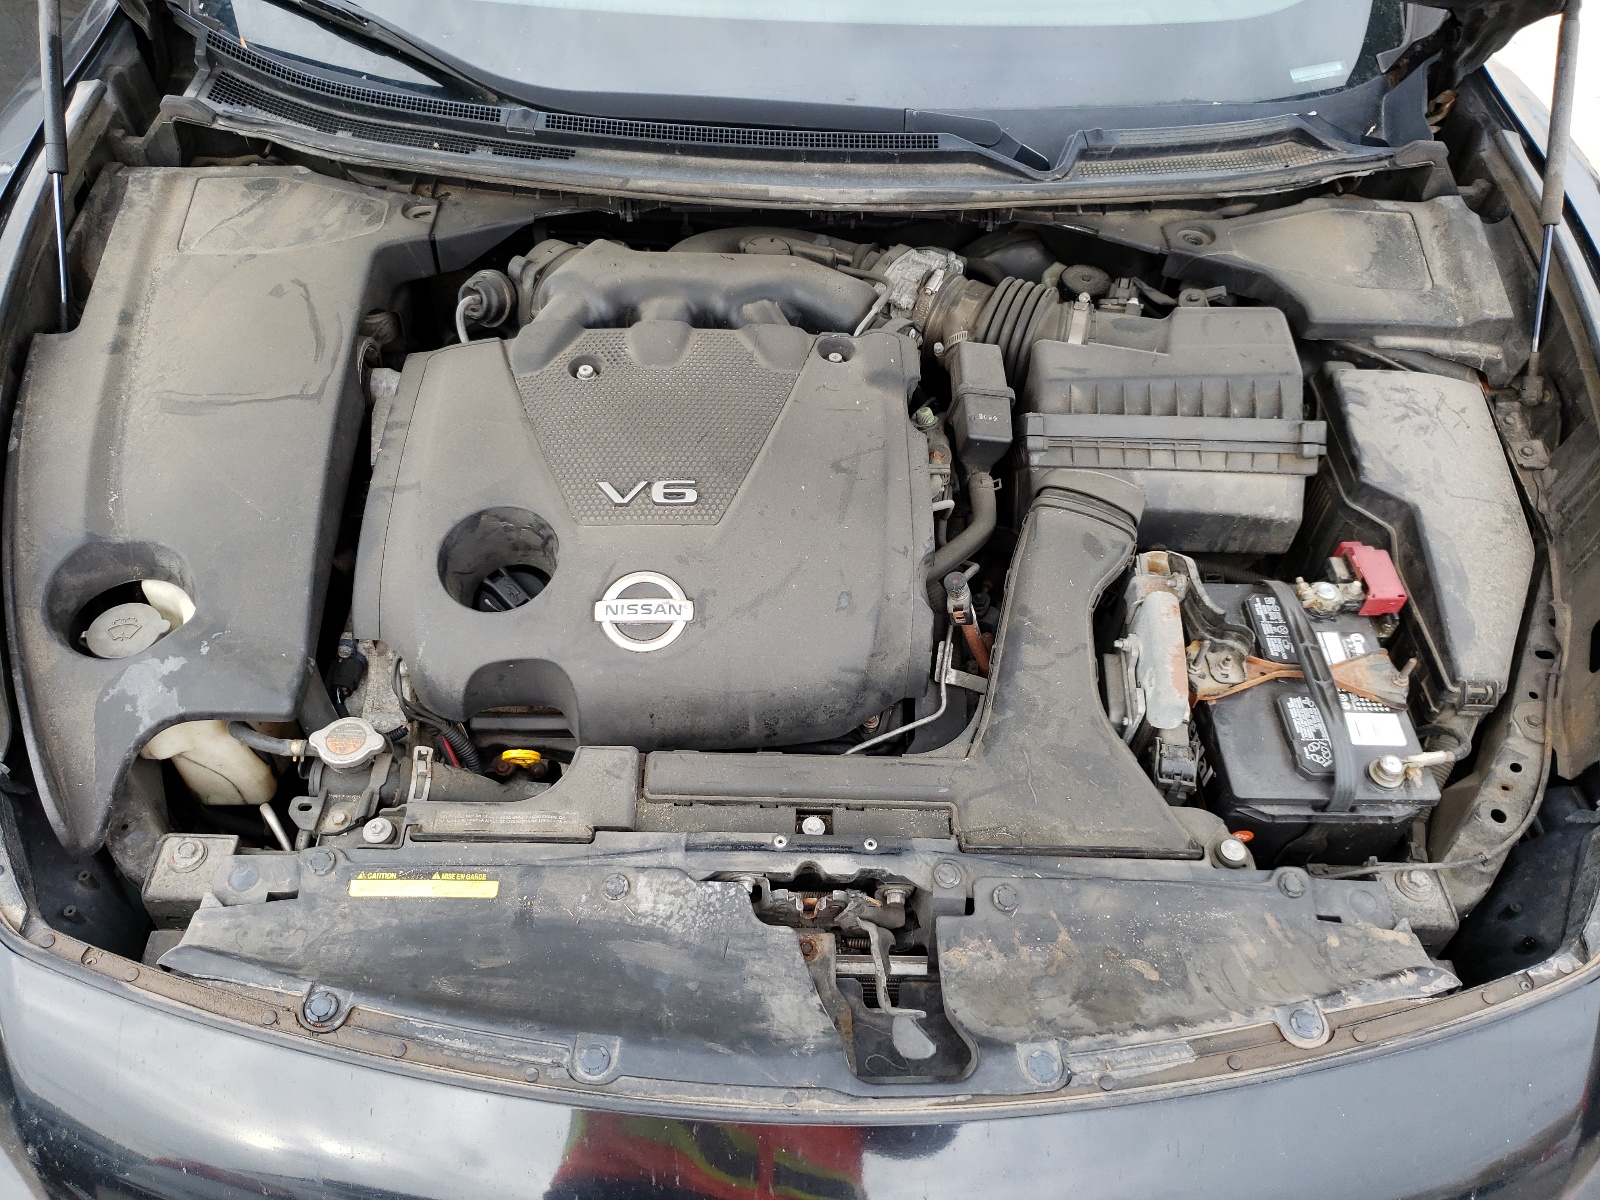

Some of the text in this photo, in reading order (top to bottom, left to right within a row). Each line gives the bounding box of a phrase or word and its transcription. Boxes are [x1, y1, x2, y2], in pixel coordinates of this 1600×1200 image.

[597, 480, 698, 505] V6
[605, 604, 683, 616] NISSAN
[367, 872, 397, 880] CAUTION
